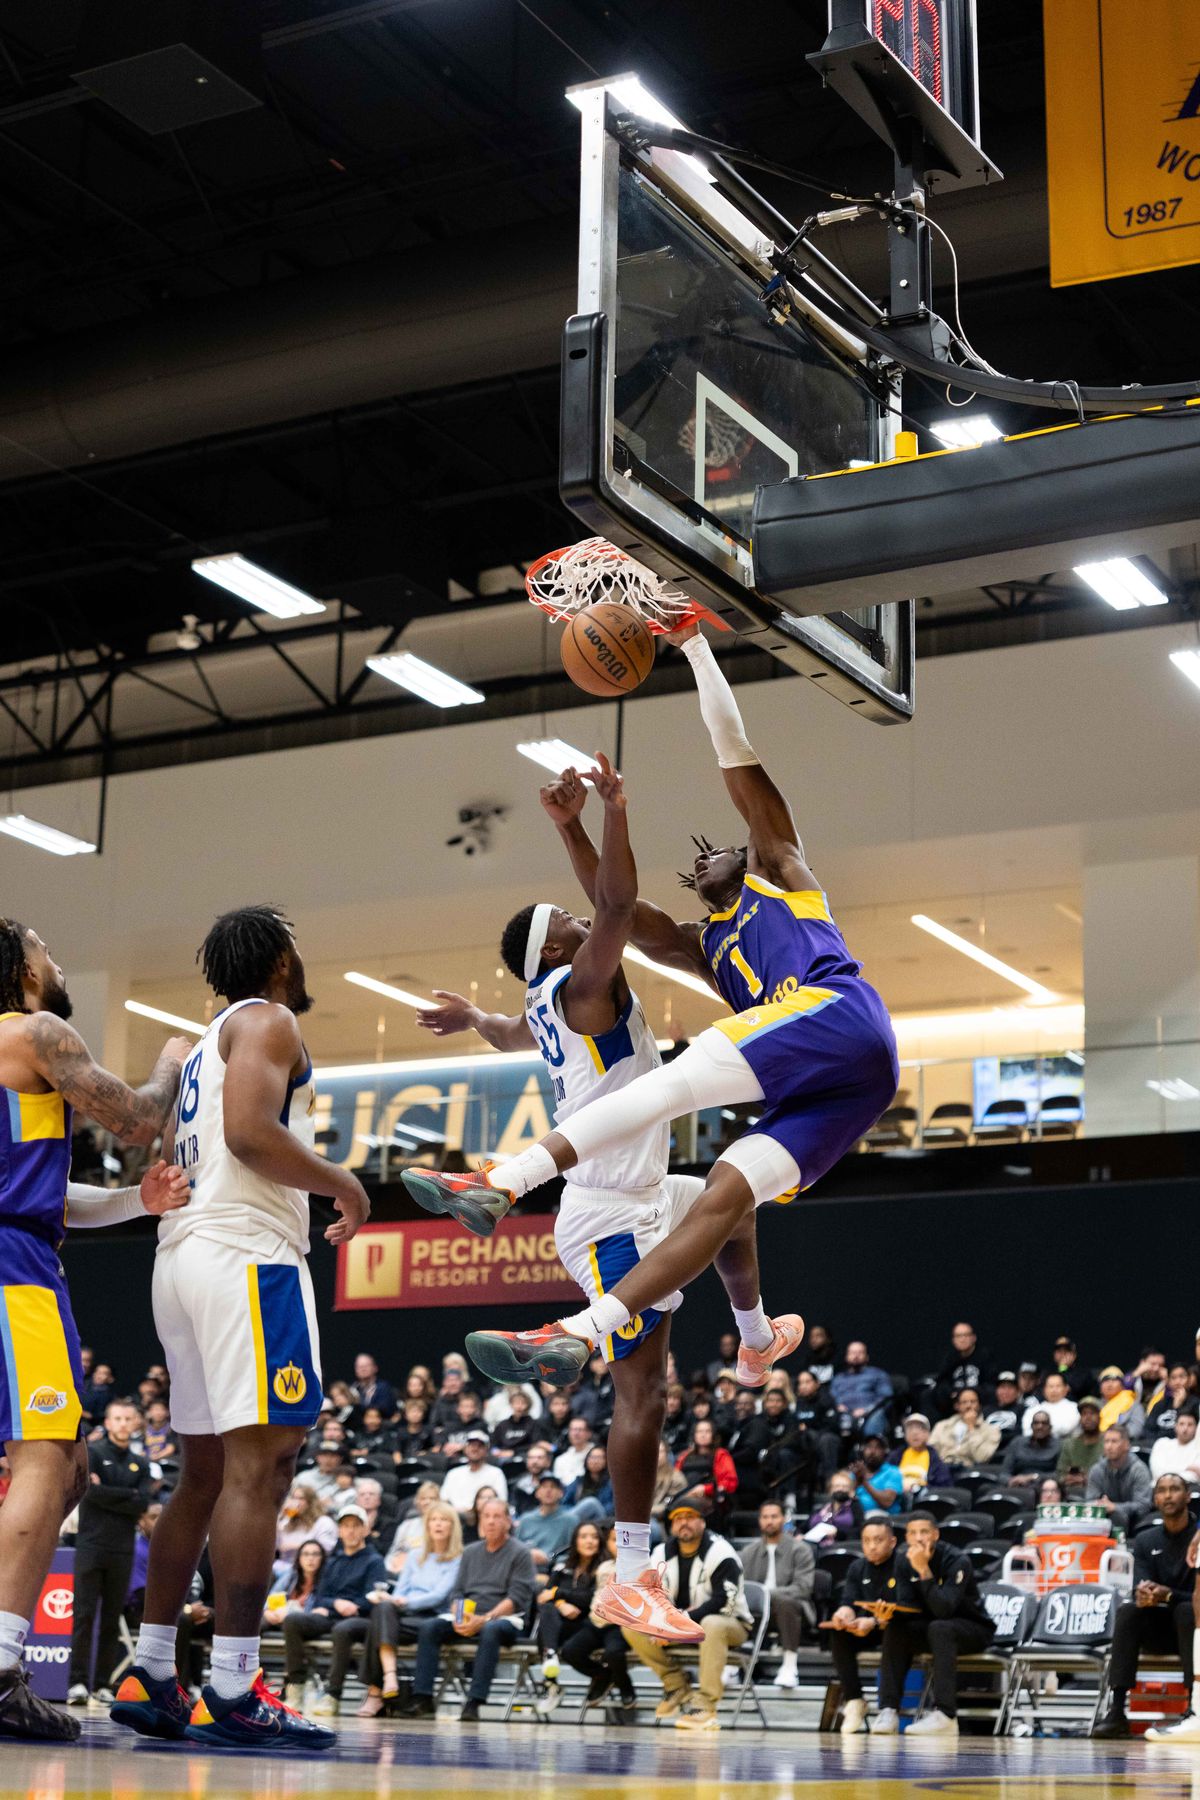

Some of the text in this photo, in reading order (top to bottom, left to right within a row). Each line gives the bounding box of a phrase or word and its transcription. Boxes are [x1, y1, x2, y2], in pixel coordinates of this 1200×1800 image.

[1123, 197, 1183, 227] 1987
[584, 625, 627, 681] Wilson
[711, 930, 740, 973] OUTH
[729, 945, 764, 999] 1
[409, 1266, 491, 1288] RESORT
[1053, 1545, 1071, 1566] G
[1067, 1613, 1108, 1635] LEAGUE
[24, 1645, 72, 1664] TOYO
